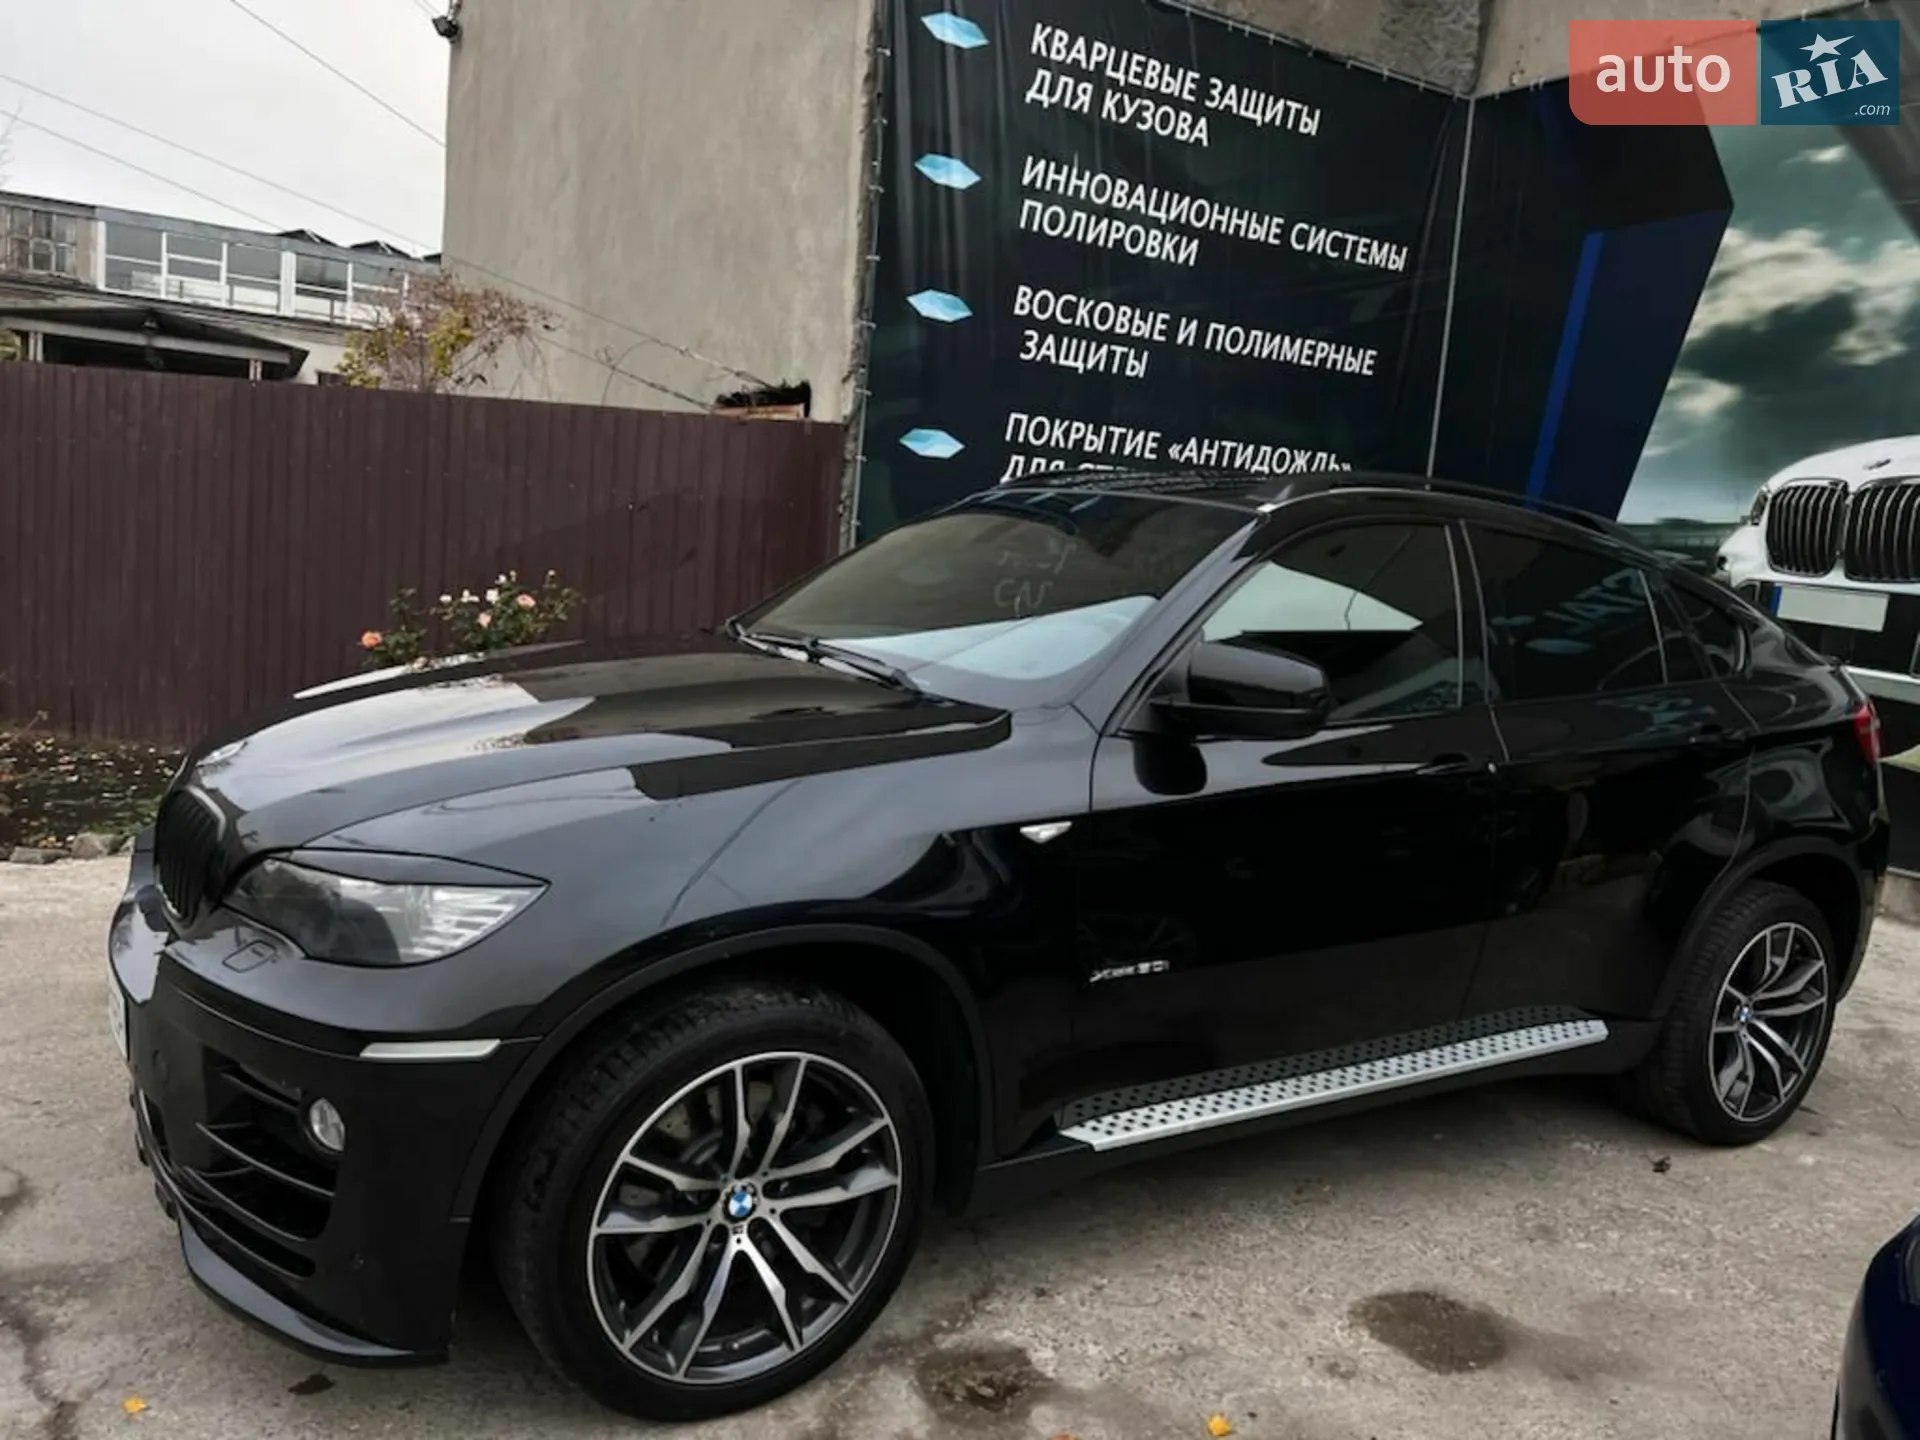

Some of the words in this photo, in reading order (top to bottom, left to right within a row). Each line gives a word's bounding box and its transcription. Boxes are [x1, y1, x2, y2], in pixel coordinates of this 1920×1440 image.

[1025, 69, 1092, 113] ДЛЯ
[1101, 92, 1210, 147] КУЗОВА
[1030, 23, 1200, 102] КВАРЦЕВЫЕ
[1204, 77, 1322, 136] ЗАЩИТЫ
[1019, 200, 1199, 267] ПОЛИРОВКИ
[1021, 156, 1284, 246] ИННОВАЦИОННЫЕ
[1290, 222, 1408, 272] СИСТЕМЫ
[1014, 286, 1168, 342] ВОСКОВЫЕ
[1176, 317, 1198, 347] И
[1204, 323, 1378, 376] ПОЛИМЕРНЫЕ
[1020, 331, 1149, 378] ЗАЩИТЫ
[1005, 412, 1162, 460] ПОКРЫТИЕ
